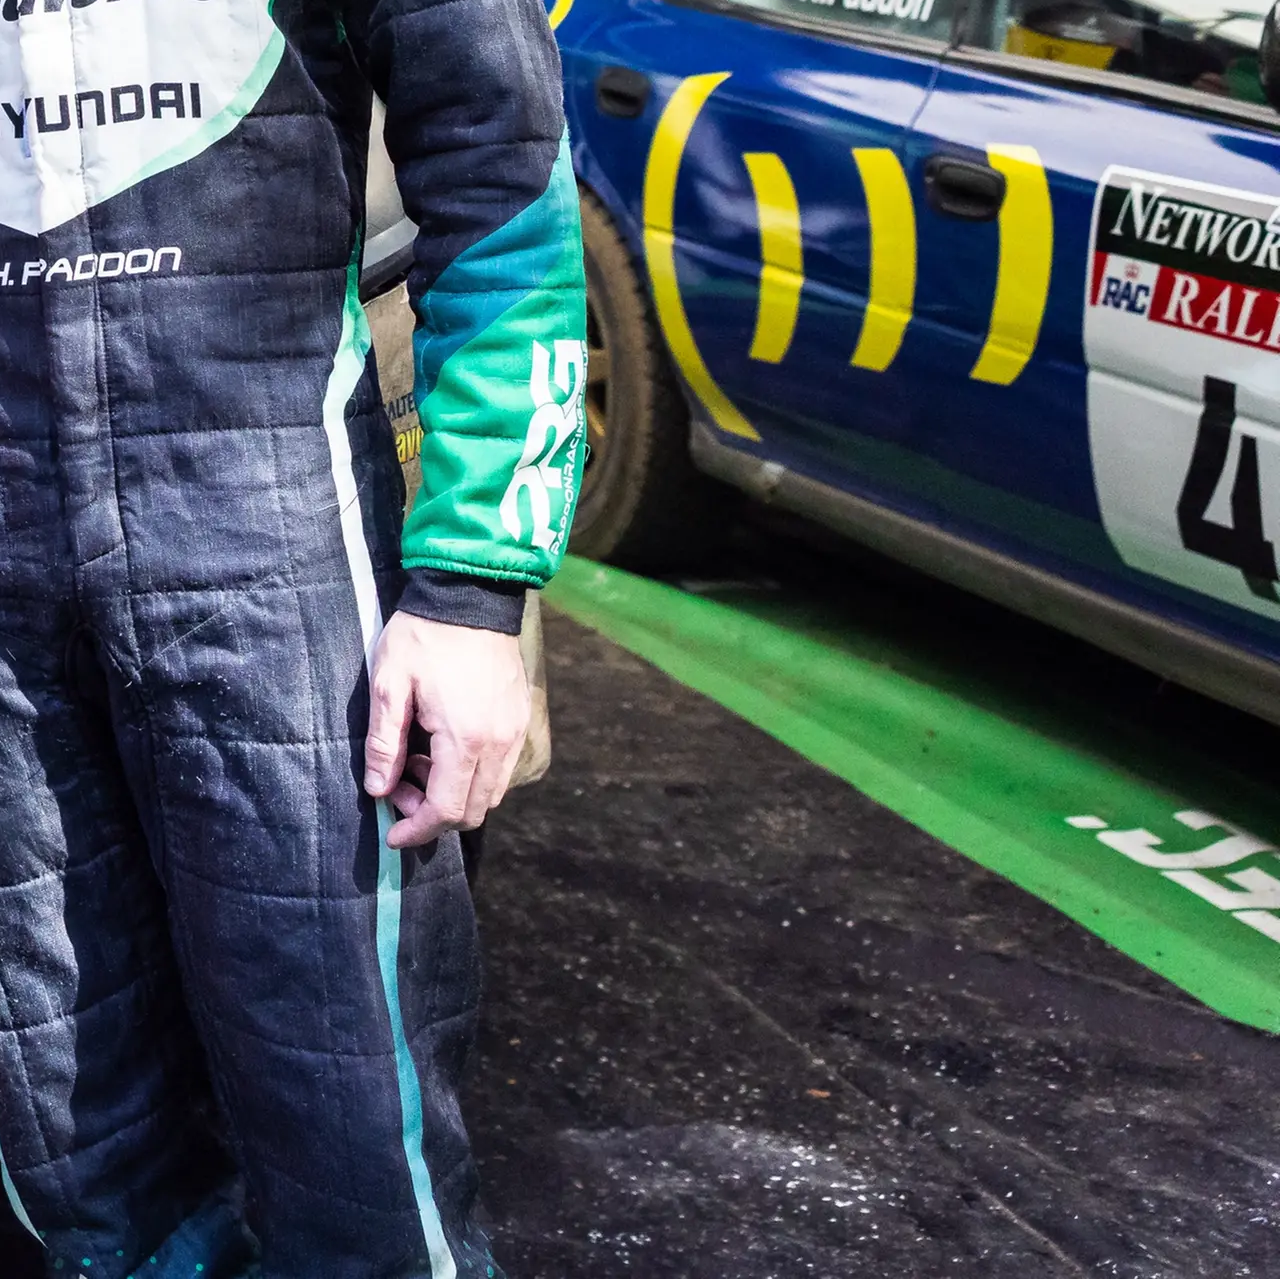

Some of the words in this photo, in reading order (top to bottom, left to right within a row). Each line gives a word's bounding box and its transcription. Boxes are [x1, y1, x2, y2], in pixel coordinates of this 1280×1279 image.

[22, 247, 181, 285] PADDON
[1109, 182, 1280, 270] NETWOR
[1102, 276, 1151, 316] RAC
[499, 339, 584, 550] PRG
[1176, 374, 1280, 604] 4
